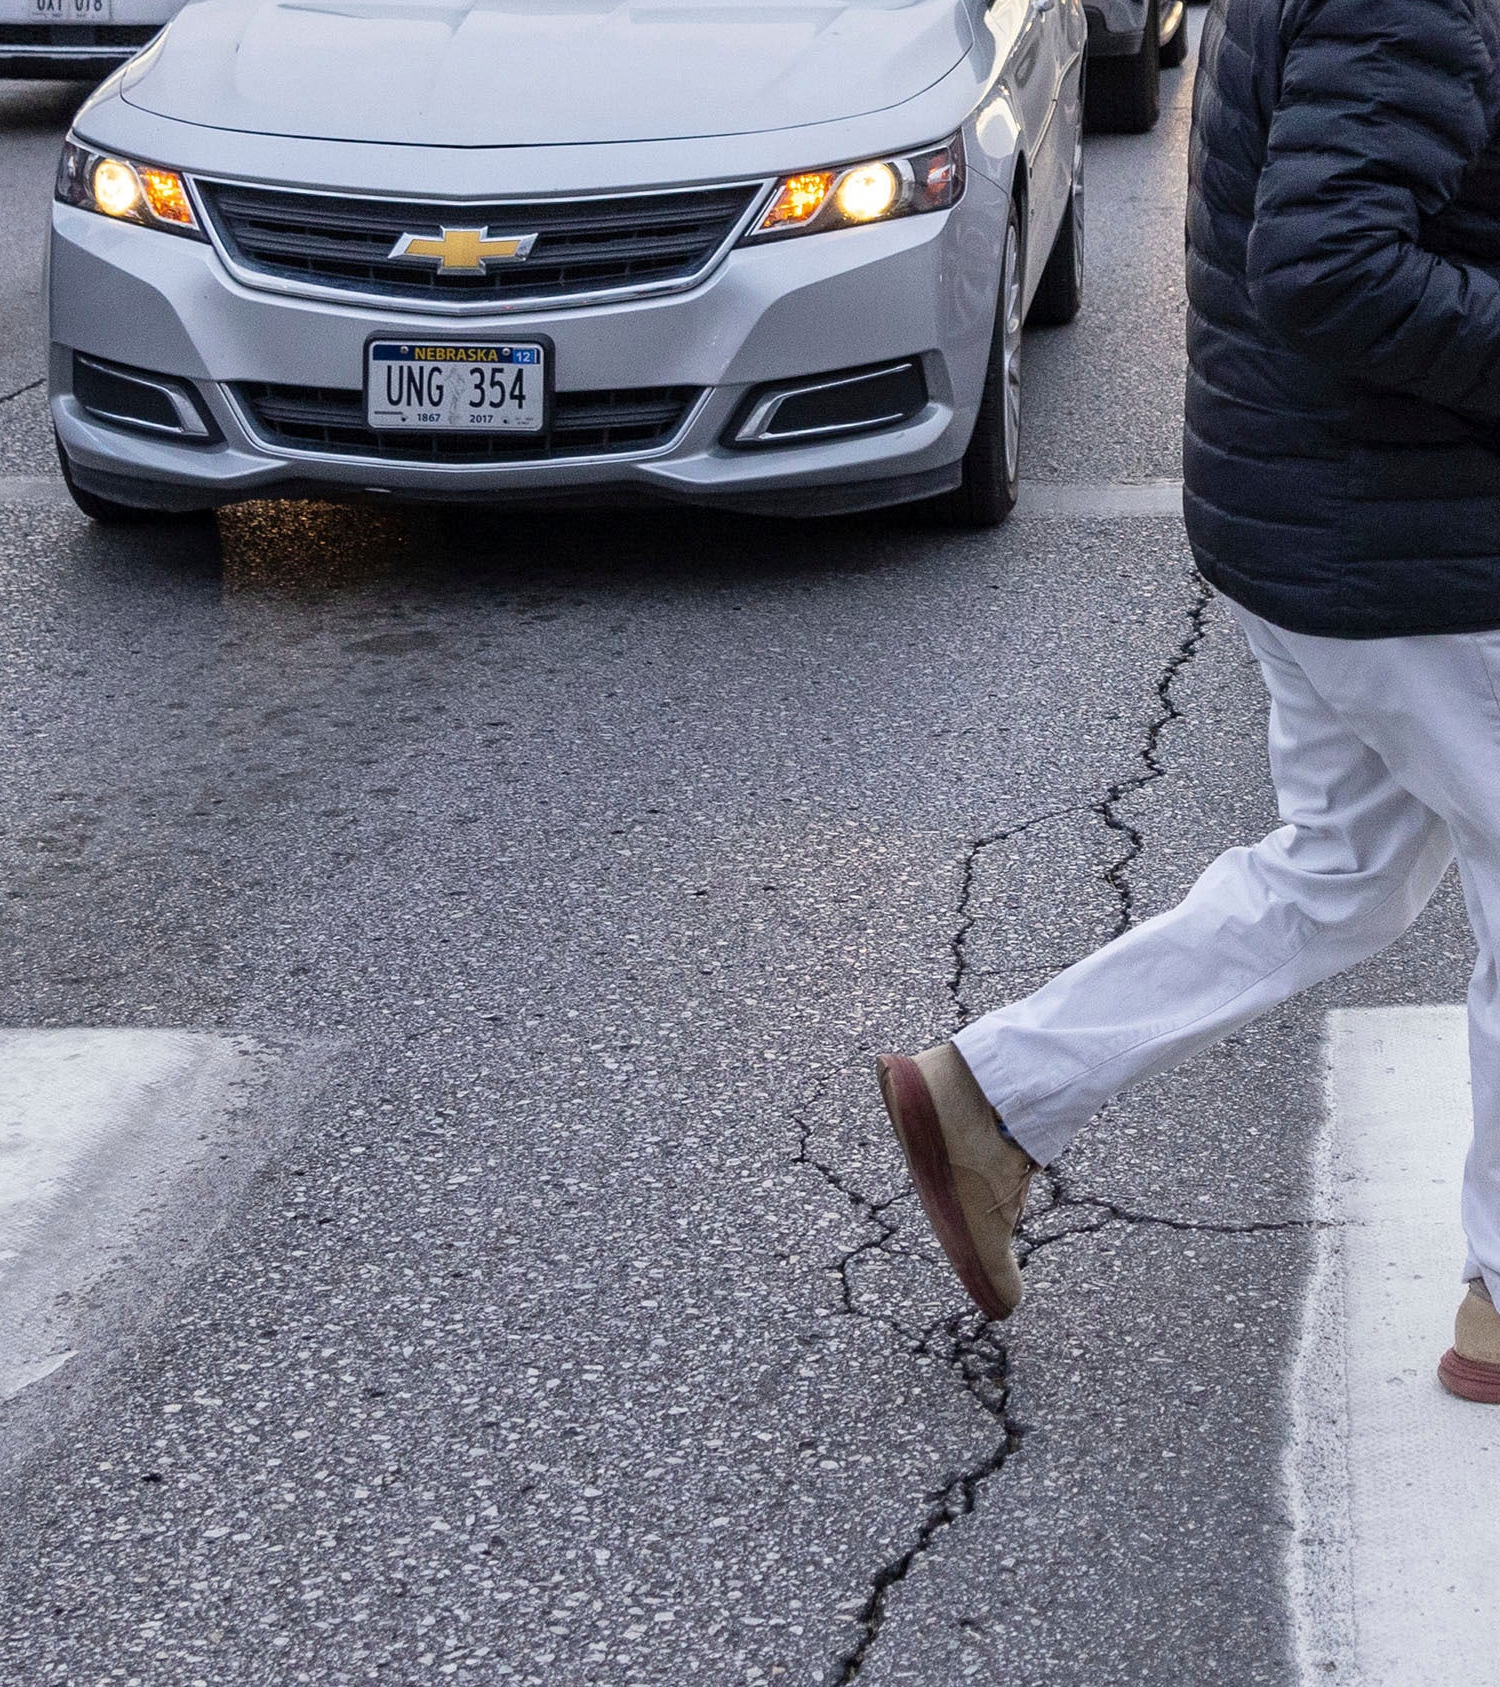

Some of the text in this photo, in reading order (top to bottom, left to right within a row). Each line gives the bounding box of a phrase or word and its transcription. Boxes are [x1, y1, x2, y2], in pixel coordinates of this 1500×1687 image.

[414, 347, 499, 362] NEBRASKA
[515, 351, 531, 362] 12
[386, 365, 526, 410] UNG 354
[416, 413, 494, 424] 1867 2017
